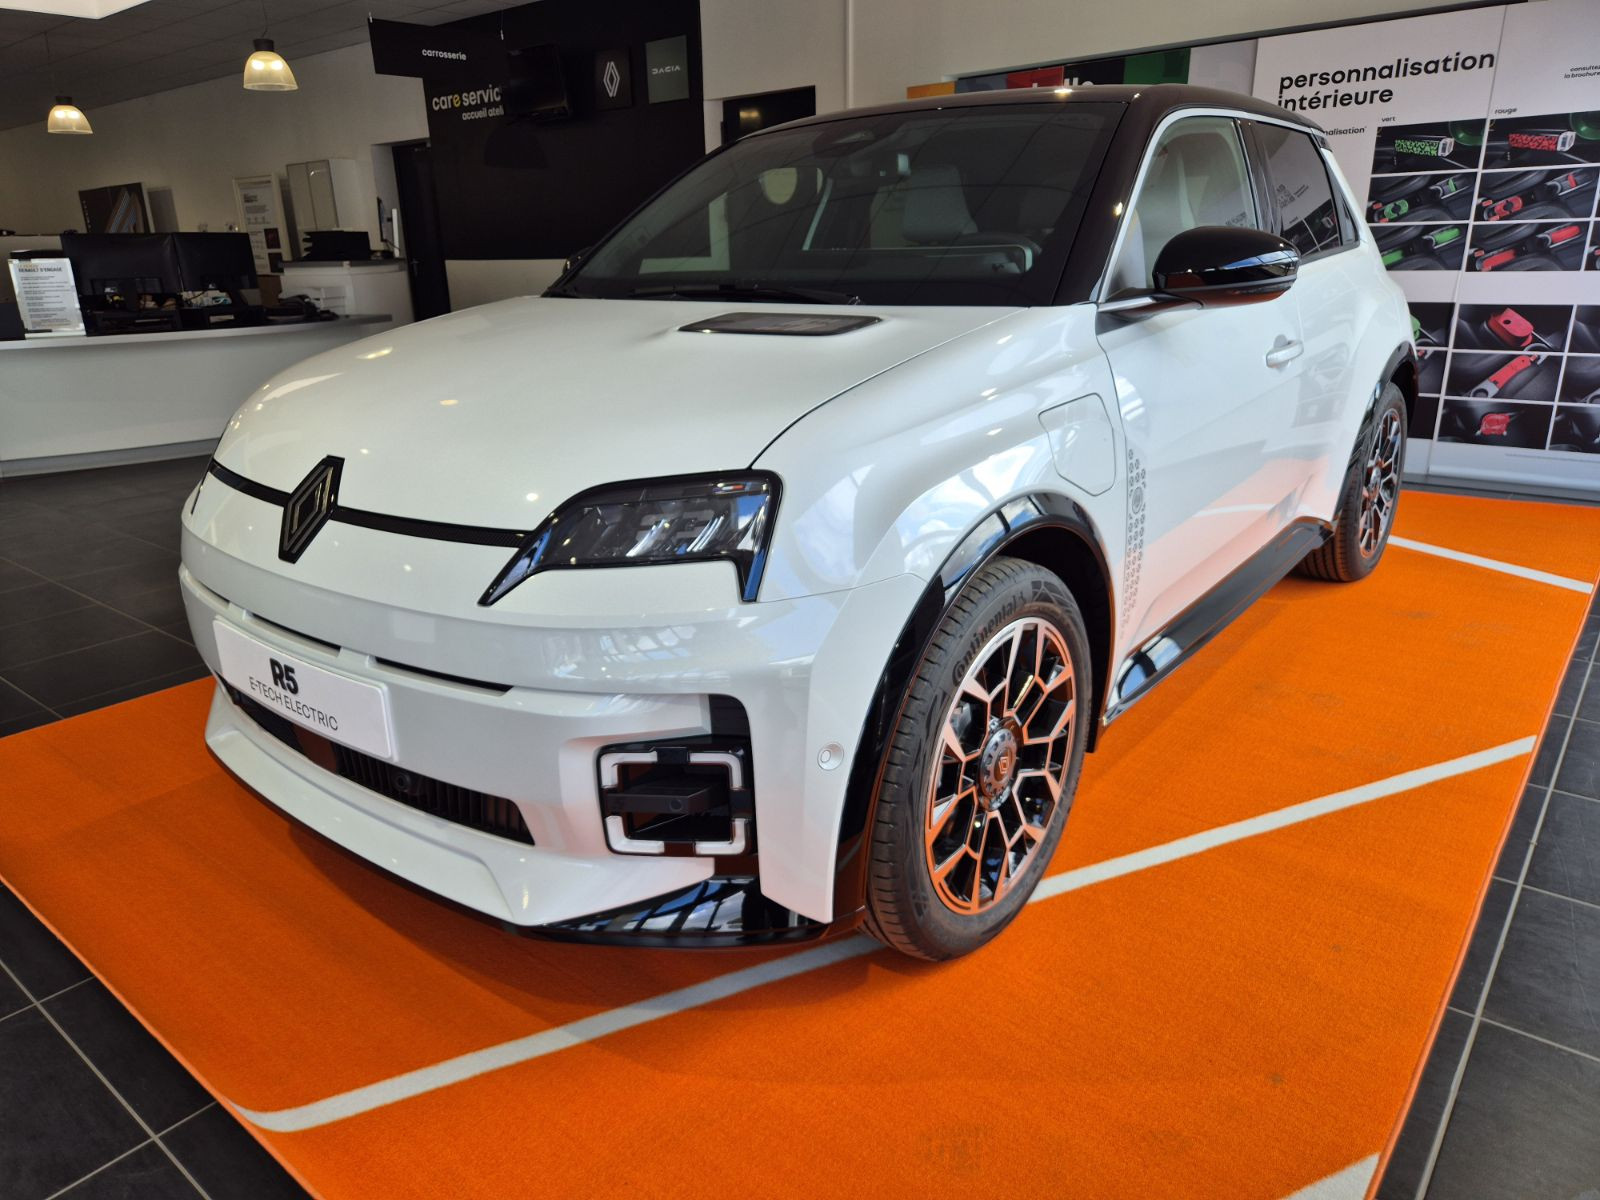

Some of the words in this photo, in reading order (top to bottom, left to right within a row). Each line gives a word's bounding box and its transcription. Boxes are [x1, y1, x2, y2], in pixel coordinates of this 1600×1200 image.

[422, 48, 467, 61] carrosserie
[651, 65, 681, 75] DACIA
[1279, 50, 1495, 95] personnalisation
[432, 93, 461, 111] care
[462, 84, 503, 107] servic
[1277, 89, 1394, 112] intérieure
[462, 108, 487, 121] accueil
[952, 594, 1018, 687] Continental
[269, 657, 299, 695] R5
[248, 676, 283, 706] E-TECH
[284, 694, 339, 731] ELECTRIC
